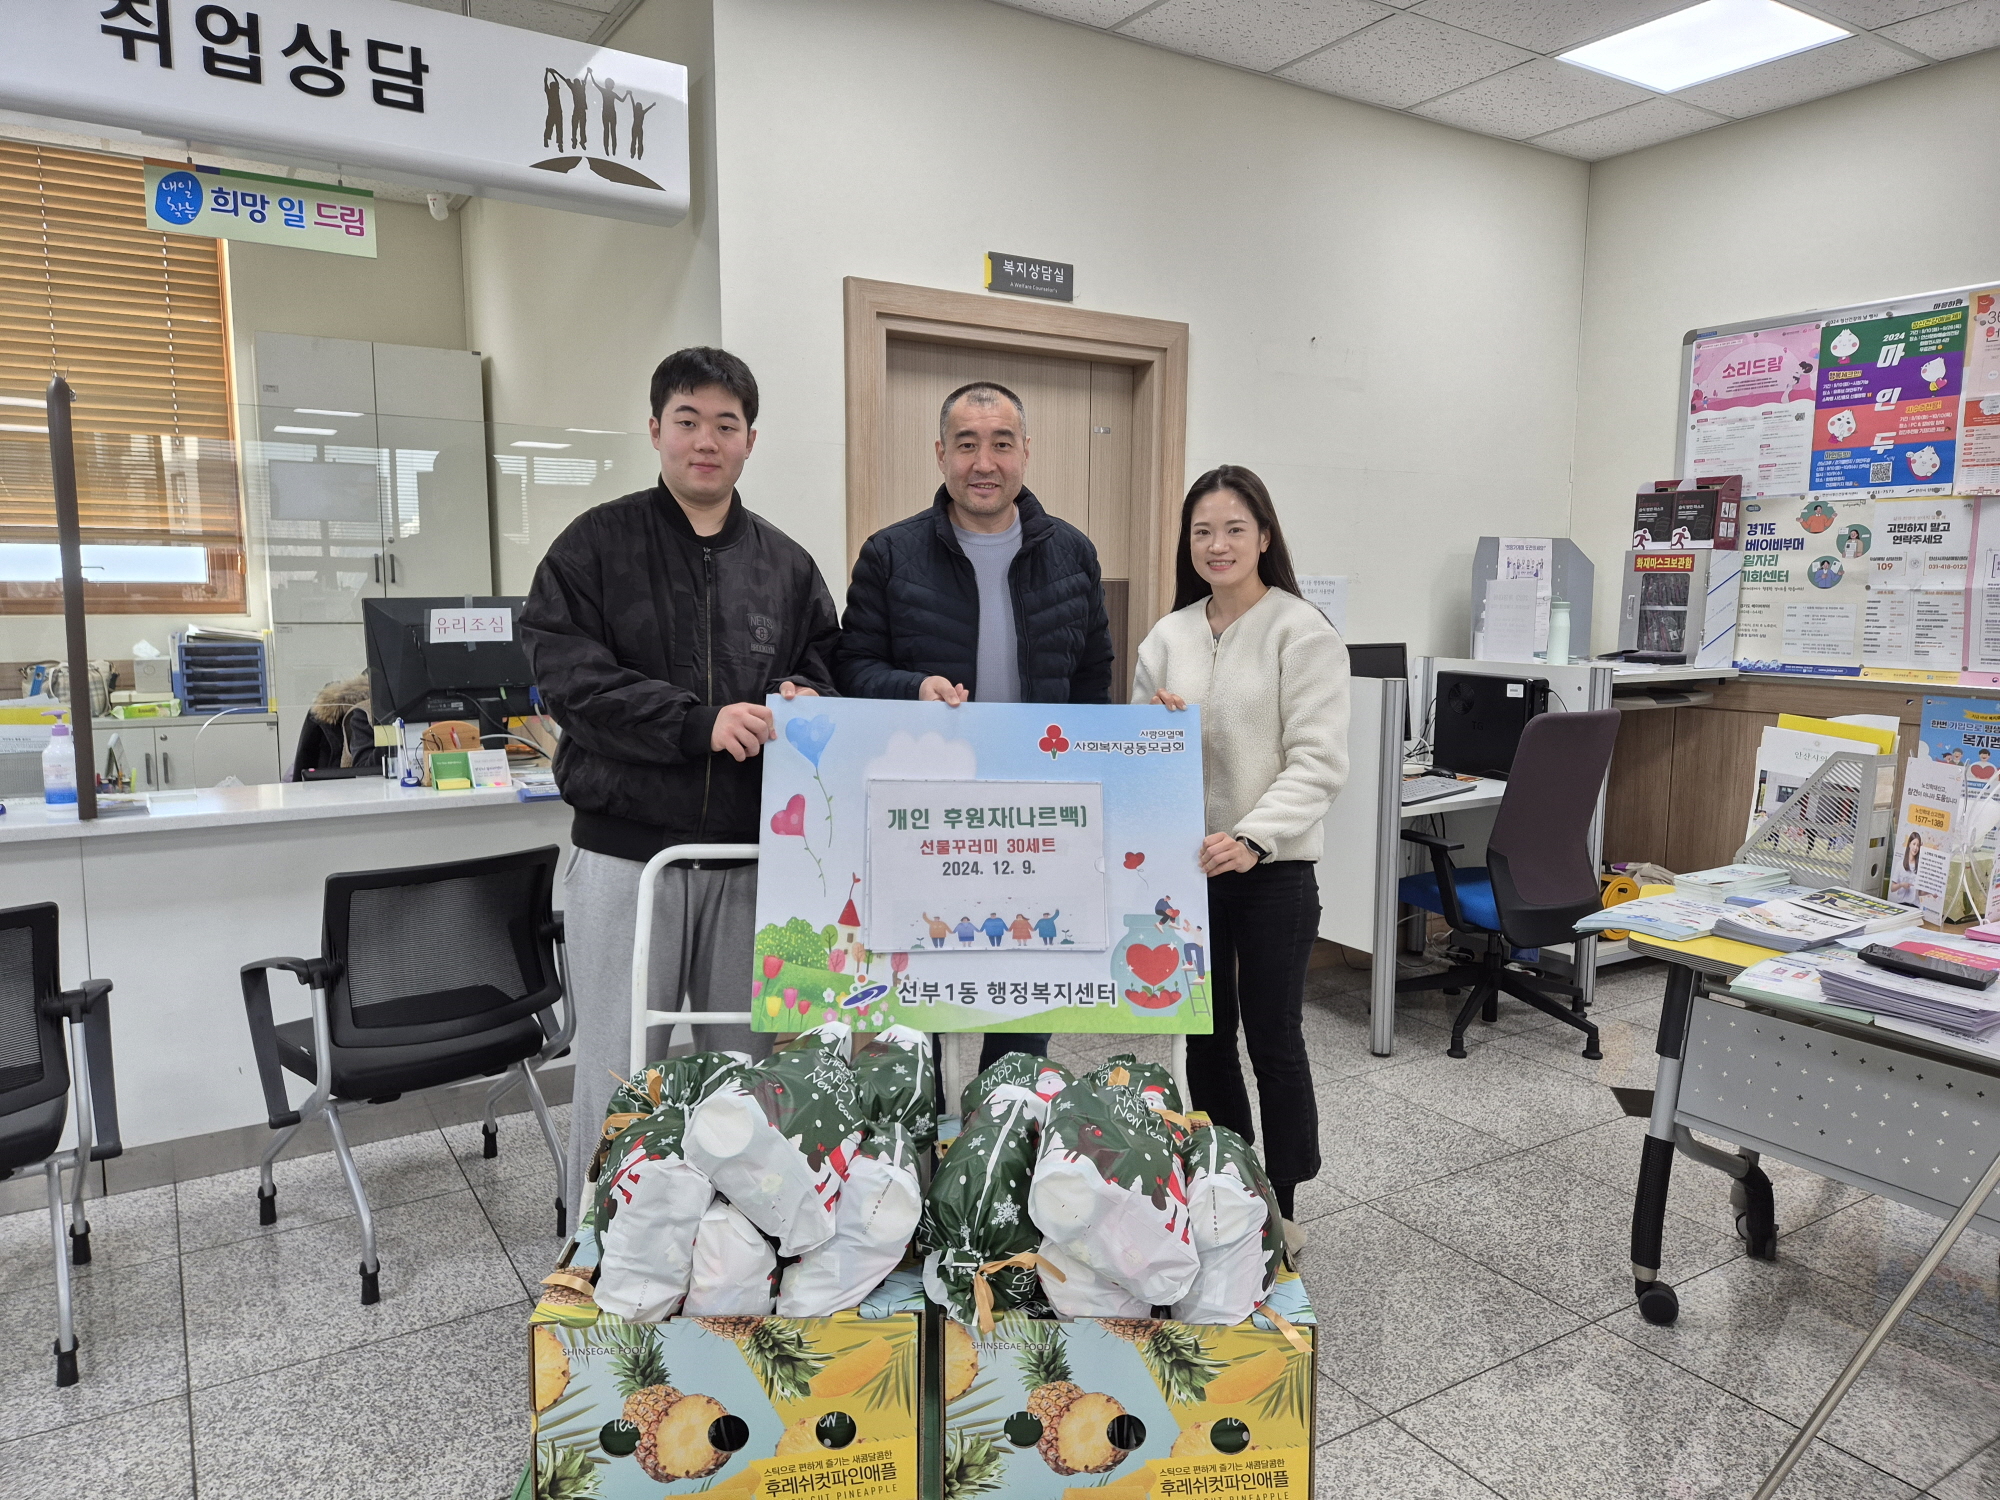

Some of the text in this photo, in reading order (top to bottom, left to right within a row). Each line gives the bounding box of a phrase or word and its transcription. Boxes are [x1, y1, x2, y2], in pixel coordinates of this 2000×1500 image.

[99, 0, 429, 113] 취업상담
[161, 180, 192, 199] 내일
[210, 186, 366, 237] 희망 일 드림
[1002, 259, 1064, 283] 복지상담실
[1882, 332, 1906, 342] 2024
[1722, 355, 1784, 379] 소리드림
[1746, 523, 1776, 536] 경기도
[1887, 522, 1951, 533] 고민하지 말고
[1745, 537, 1805, 551] 베이비부머
[1892, 534, 1943, 545] 연락주세요
[1636, 557, 1693, 569] 화재마스크보관함
[1744, 554, 1779, 567] 일자리
[1877, 563, 1894, 571] 109
[435, 616, 504, 635] 유리조심
[750, 615, 773, 630] NETS
[750, 643, 776, 656] BROOKLYN
[1140, 730, 1184, 739] 사랑의열매
[1931, 720, 1948, 729] 한번
[1949, 721, 1983, 732] 가입으로
[1074, 741, 1184, 756] 사회복지공동모금회
[887, 804, 1088, 831] 개인 후원자(나르백)
[1914, 814, 1944, 828] 1577-1389
[919, 837, 1056, 856] 선물꾸러미 30세트
[942, 859, 1036, 877] 2024. 12. 9.
[898, 981, 1117, 1006] 선부1동 행정복지센터
[803, 1071, 835, 1095] New
[1113, 1103, 1143, 1129] New
[562, 1346, 647, 1356] SHINSEGAE FOOD
[971, 1341, 1051, 1351] SHINSEGAE FOOD
[763, 1449, 893, 1478] 스틱으로 편하게 즐기는 새콤달콤한
[1159, 1458, 1285, 1477] 스틱으로 편하게 즐기는 새콤달콤한
[764, 1461, 898, 1498] 후레쉬컷파인애플
[1159, 1470, 1290, 1498] 후레쉬컷파인애플
[836, 1483, 898, 1500] PINEAPPLE
